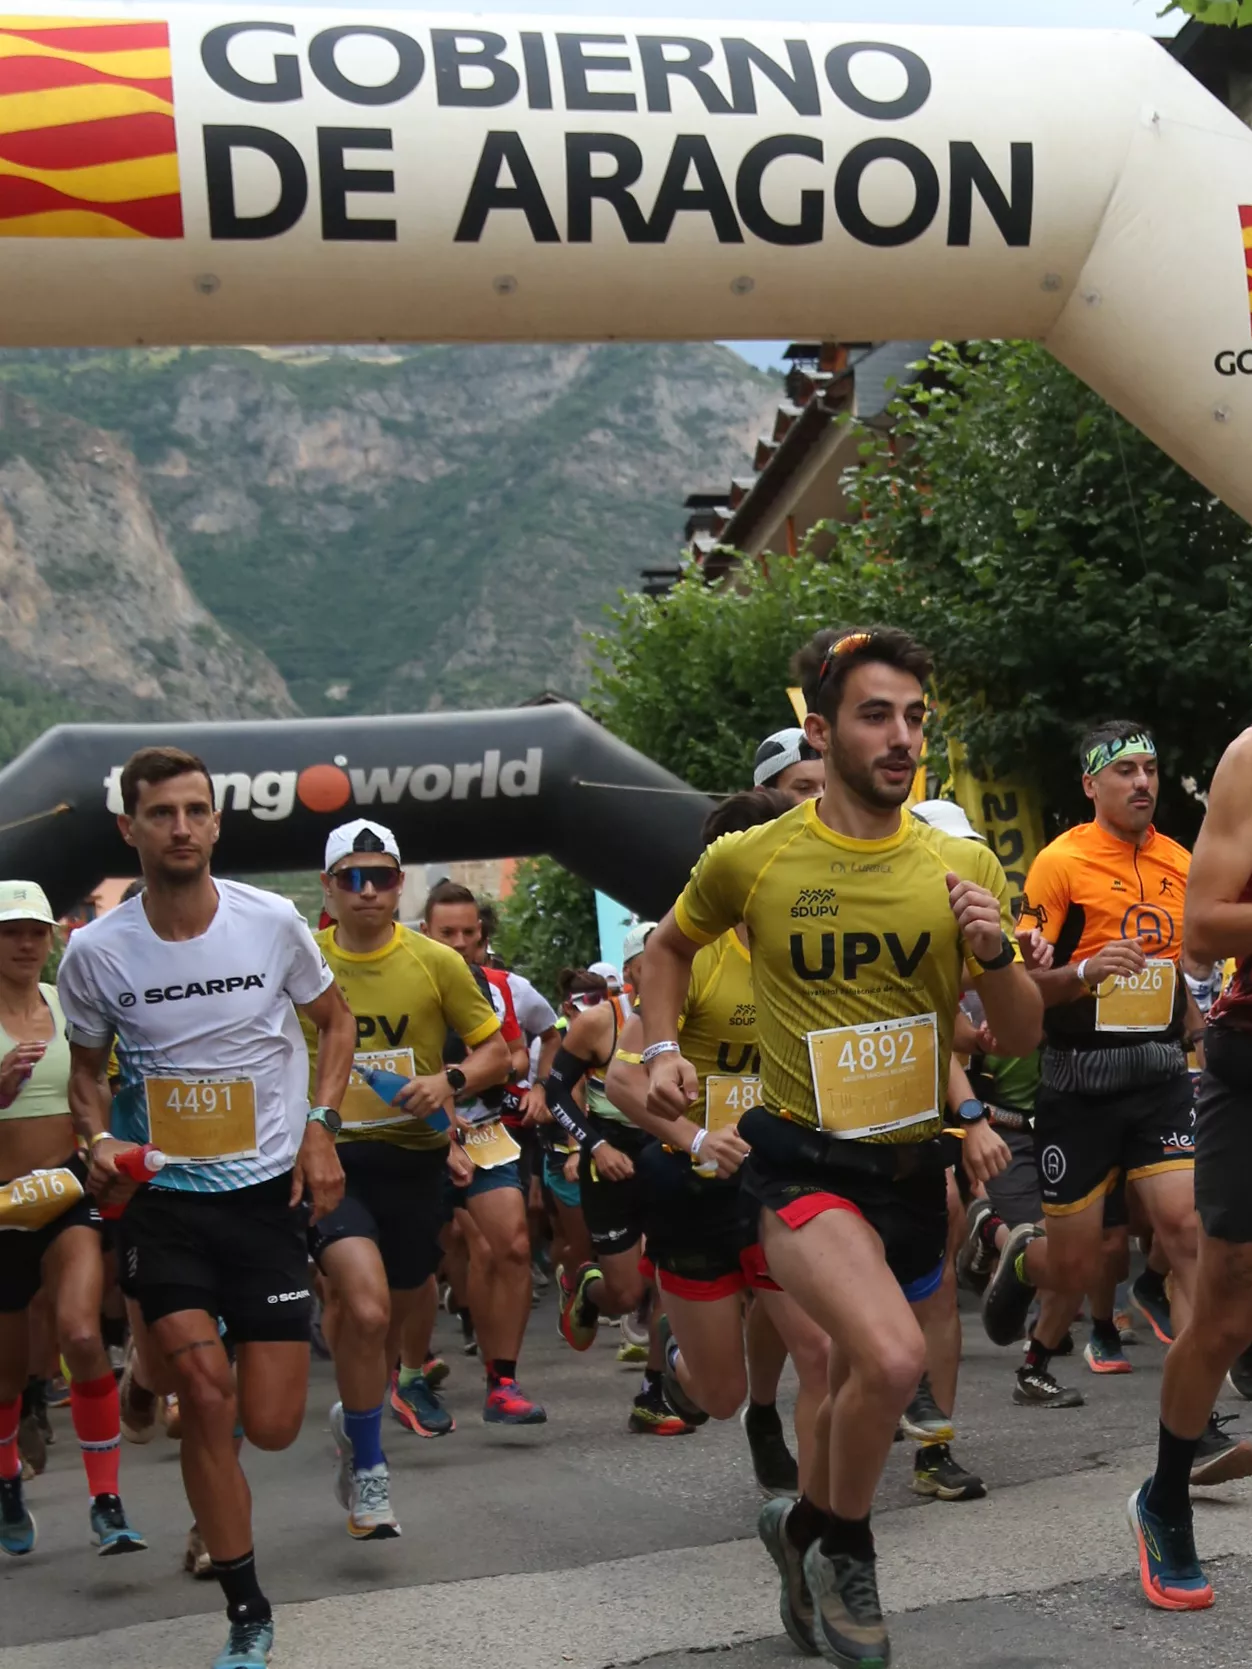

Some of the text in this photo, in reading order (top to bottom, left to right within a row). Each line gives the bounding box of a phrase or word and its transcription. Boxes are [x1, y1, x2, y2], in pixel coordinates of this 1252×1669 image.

[200, 20, 932, 121] GOBIERNO
[202, 123, 1034, 248] DE ARAGON
[790, 905, 839, 917] SDUPV
[790, 931, 931, 981] UPV
[144, 974, 265, 1004] SCARPA
[1114, 968, 1163, 990] 4626
[355, 1014, 410, 1048] PV
[729, 1017, 756, 1026] SDUP
[837, 1031, 917, 1072] 4892
[166, 1086, 232, 1113] 4491
[725, 1084, 763, 1110] 48
[1160, 1132, 1195, 1147] ide
[10, 1175, 65, 1205] 4516
